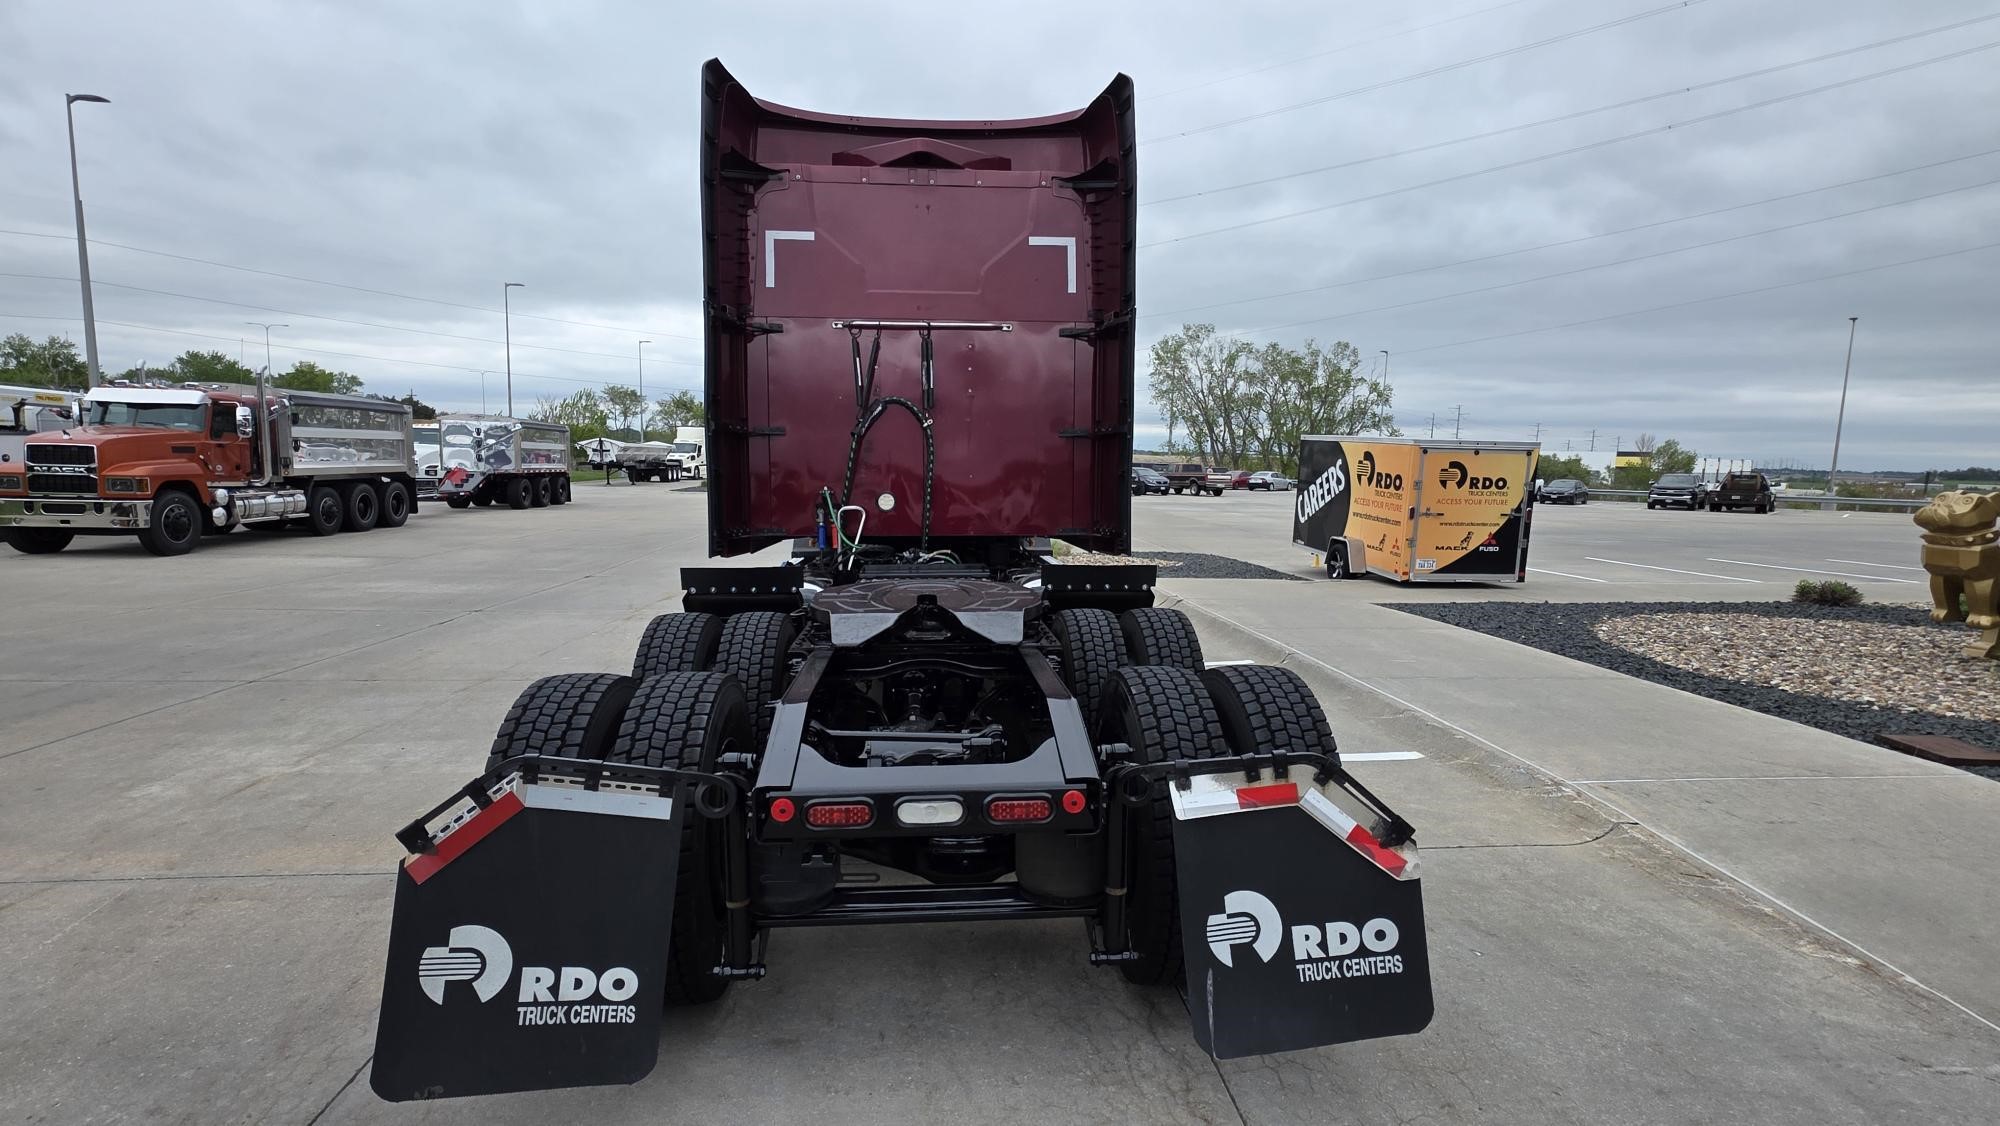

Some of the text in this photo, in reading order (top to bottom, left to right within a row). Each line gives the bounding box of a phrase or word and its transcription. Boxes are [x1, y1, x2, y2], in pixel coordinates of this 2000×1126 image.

[33, 466, 88, 474] MACK
[1298, 458, 1345, 524] CAREERS
[1375, 471, 1403, 491] RDO
[1469, 477, 1508, 490] RDO
[1371, 500, 1384, 509] YOUR
[1384, 502, 1402, 513] FUTURE
[1435, 498, 1509, 506] ACCESS YOUR FUTURE
[1366, 544, 1384, 552] MACK
[1291, 917, 1400, 961] RDO
[1296, 954, 1404, 983] TRUCK CENTERS
[517, 966, 639, 1003] RDO
[517, 1004, 636, 1026] TRUCK CENTERS
